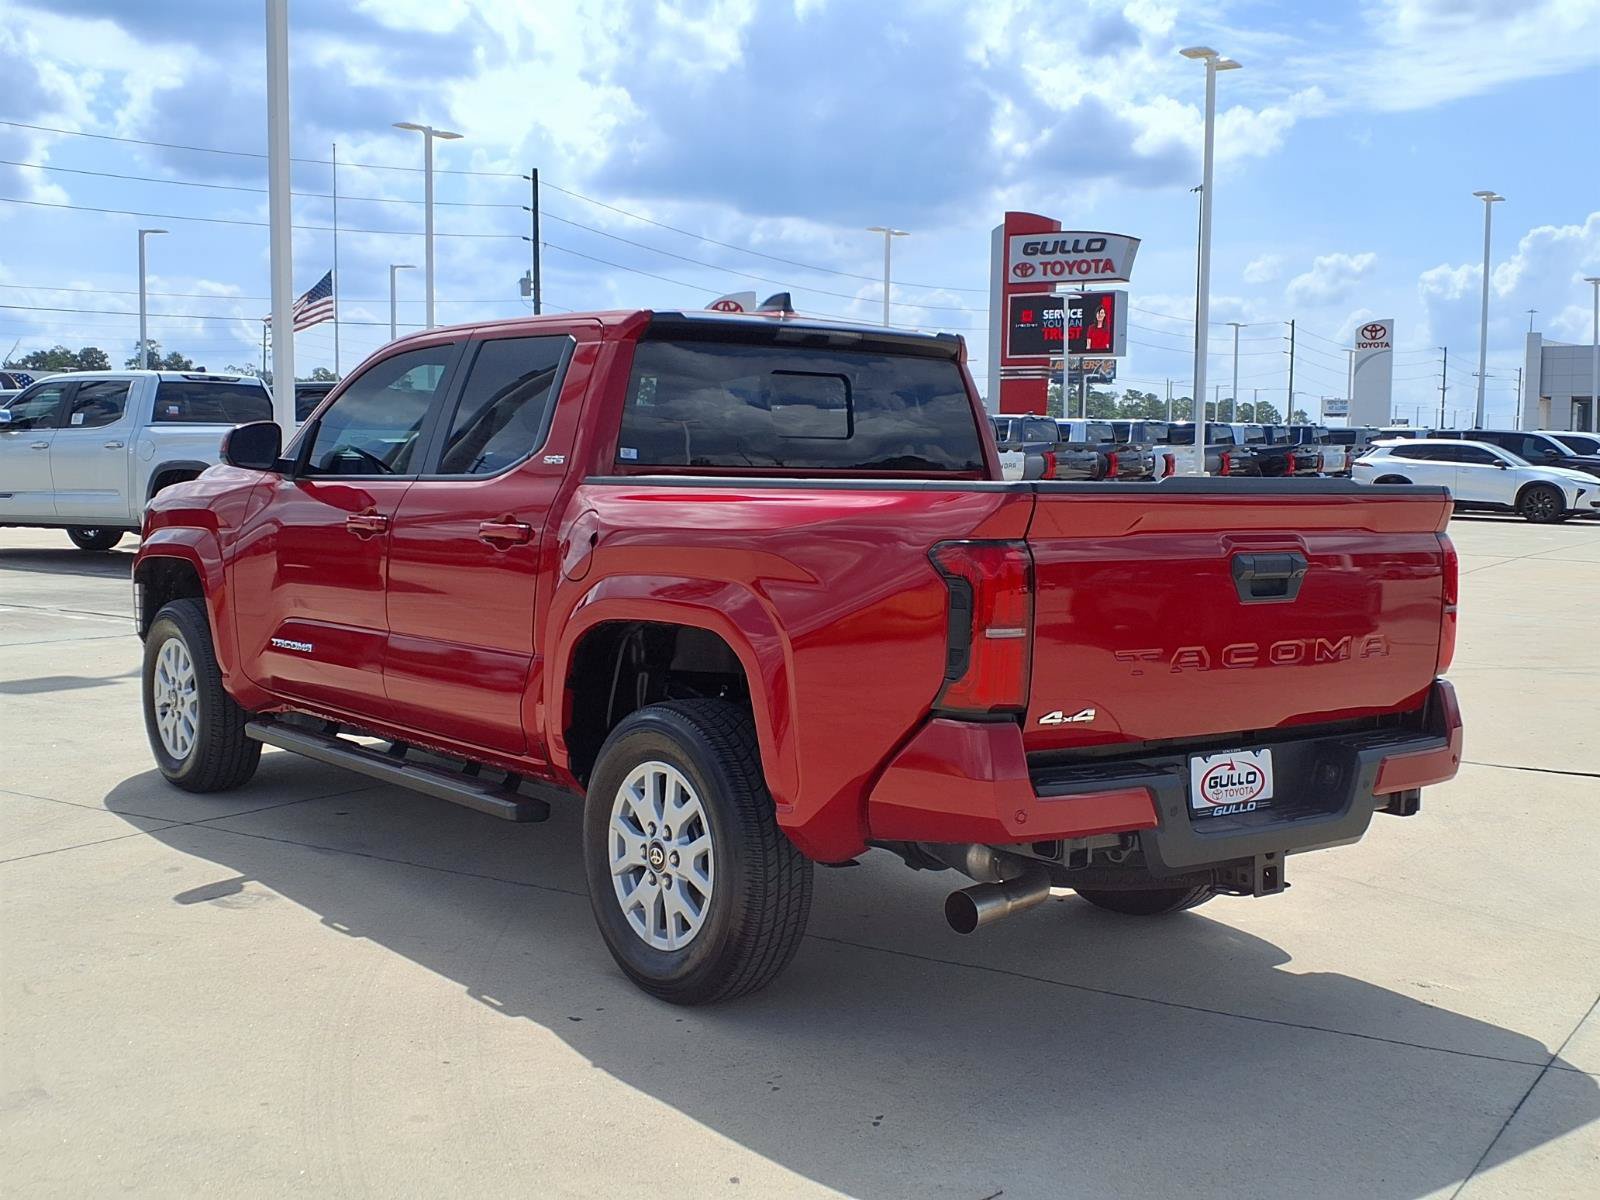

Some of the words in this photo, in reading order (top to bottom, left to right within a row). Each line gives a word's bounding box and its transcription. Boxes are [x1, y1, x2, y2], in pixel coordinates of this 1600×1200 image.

[1022, 238, 1107, 256] GULLO
[1039, 258, 1116, 277] TOYOTA
[1043, 308, 1083, 320] SERVICE
[1043, 319, 1062, 328] YOU
[1356, 341, 1391, 349] TOYOTA
[271, 637, 313, 652] TACOMA
[1113, 633, 1392, 676] TACOMA
[1038, 708, 1096, 726] 4x4
[1208, 771, 1257, 789] GULLO
[1224, 786, 1255, 798] TOYOTA
[1212, 801, 1257, 816] GULLO
